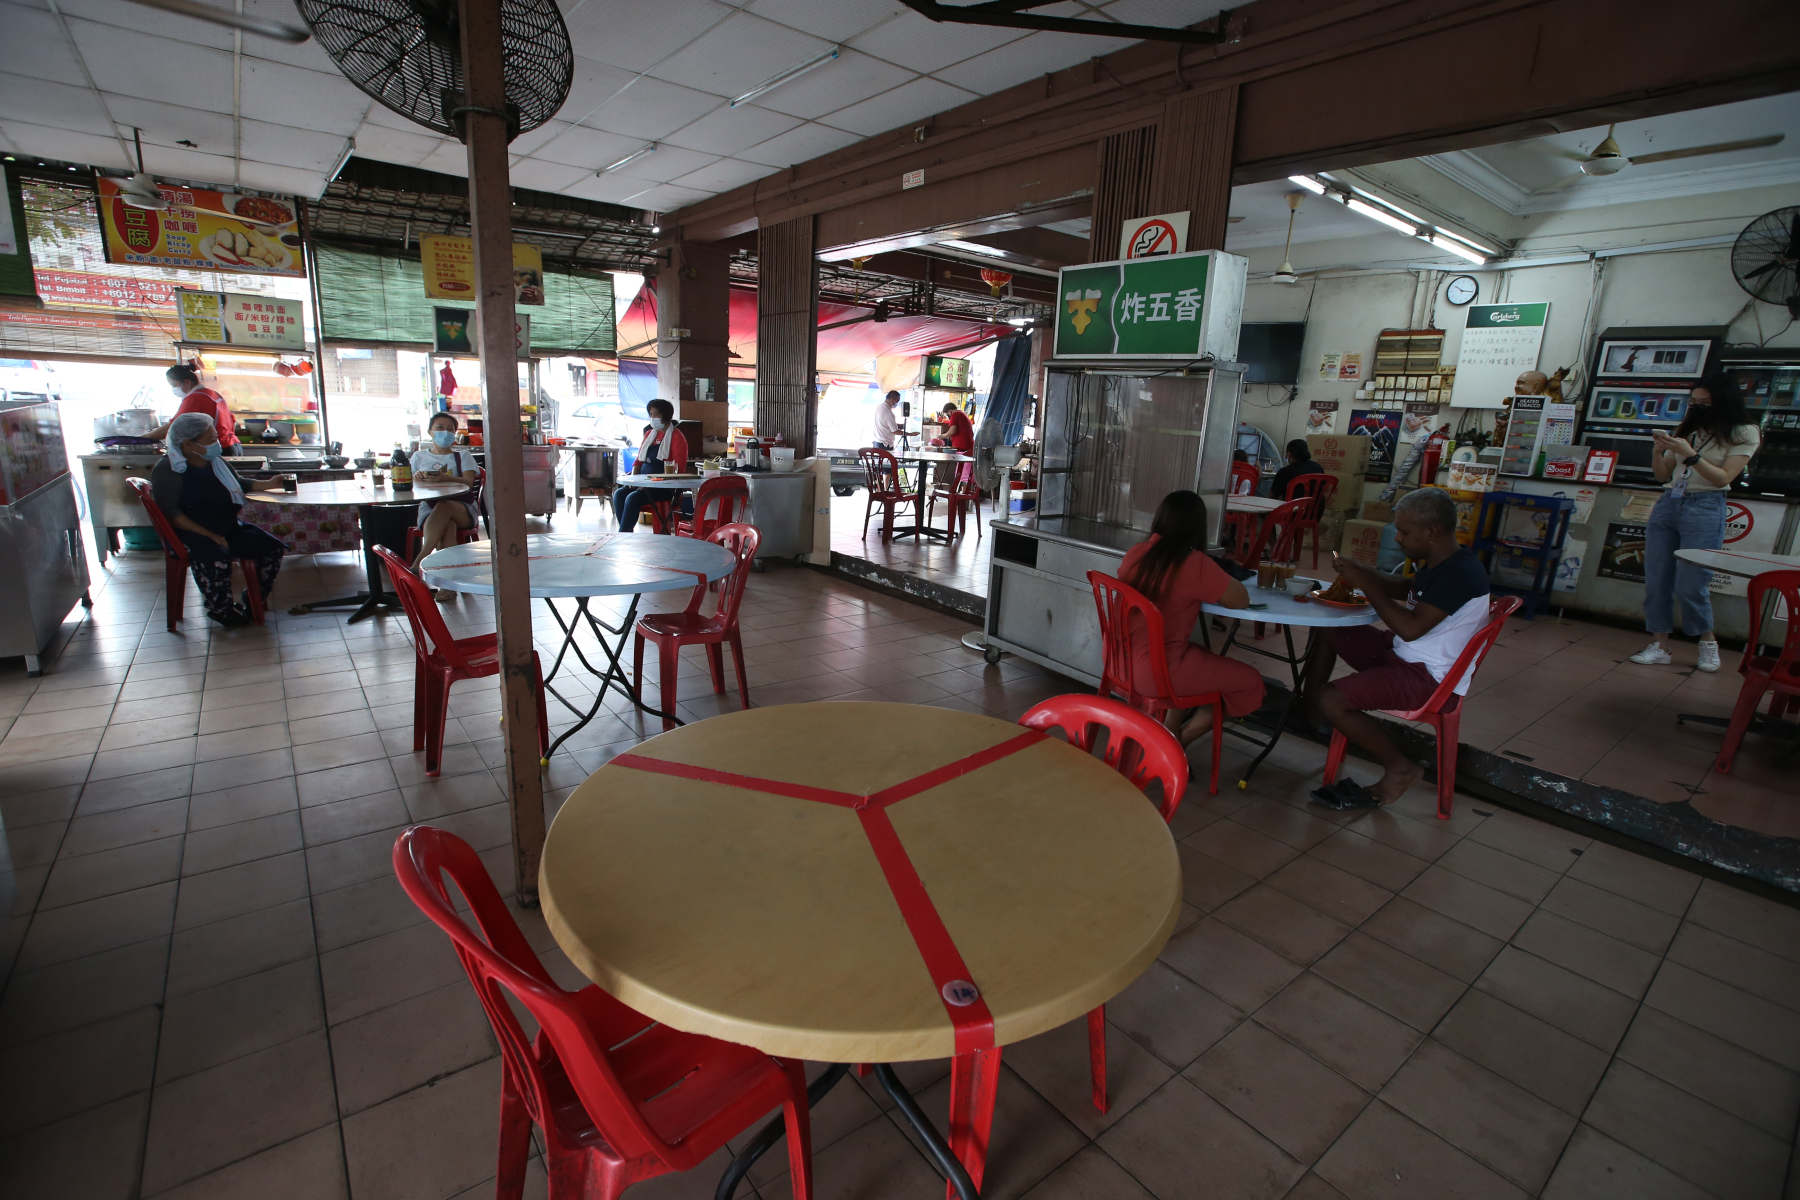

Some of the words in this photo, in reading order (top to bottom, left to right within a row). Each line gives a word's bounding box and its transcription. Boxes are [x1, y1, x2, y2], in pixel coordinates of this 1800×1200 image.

[166, 234, 187, 242] Soup
[167, 241, 192, 249] Kicap
[168, 248, 192, 256] Curry
[56, 286, 87, 294] Bimbit
[1120, 287, 1202, 324] 炸五香
[1490, 311, 1520, 323] Carlsberg
[1546, 464, 1572, 474] Boost
[1505, 496, 1524, 504] Tiger
[1492, 544, 1510, 553] Tiger
[953, 987, 976, 1002] 14
